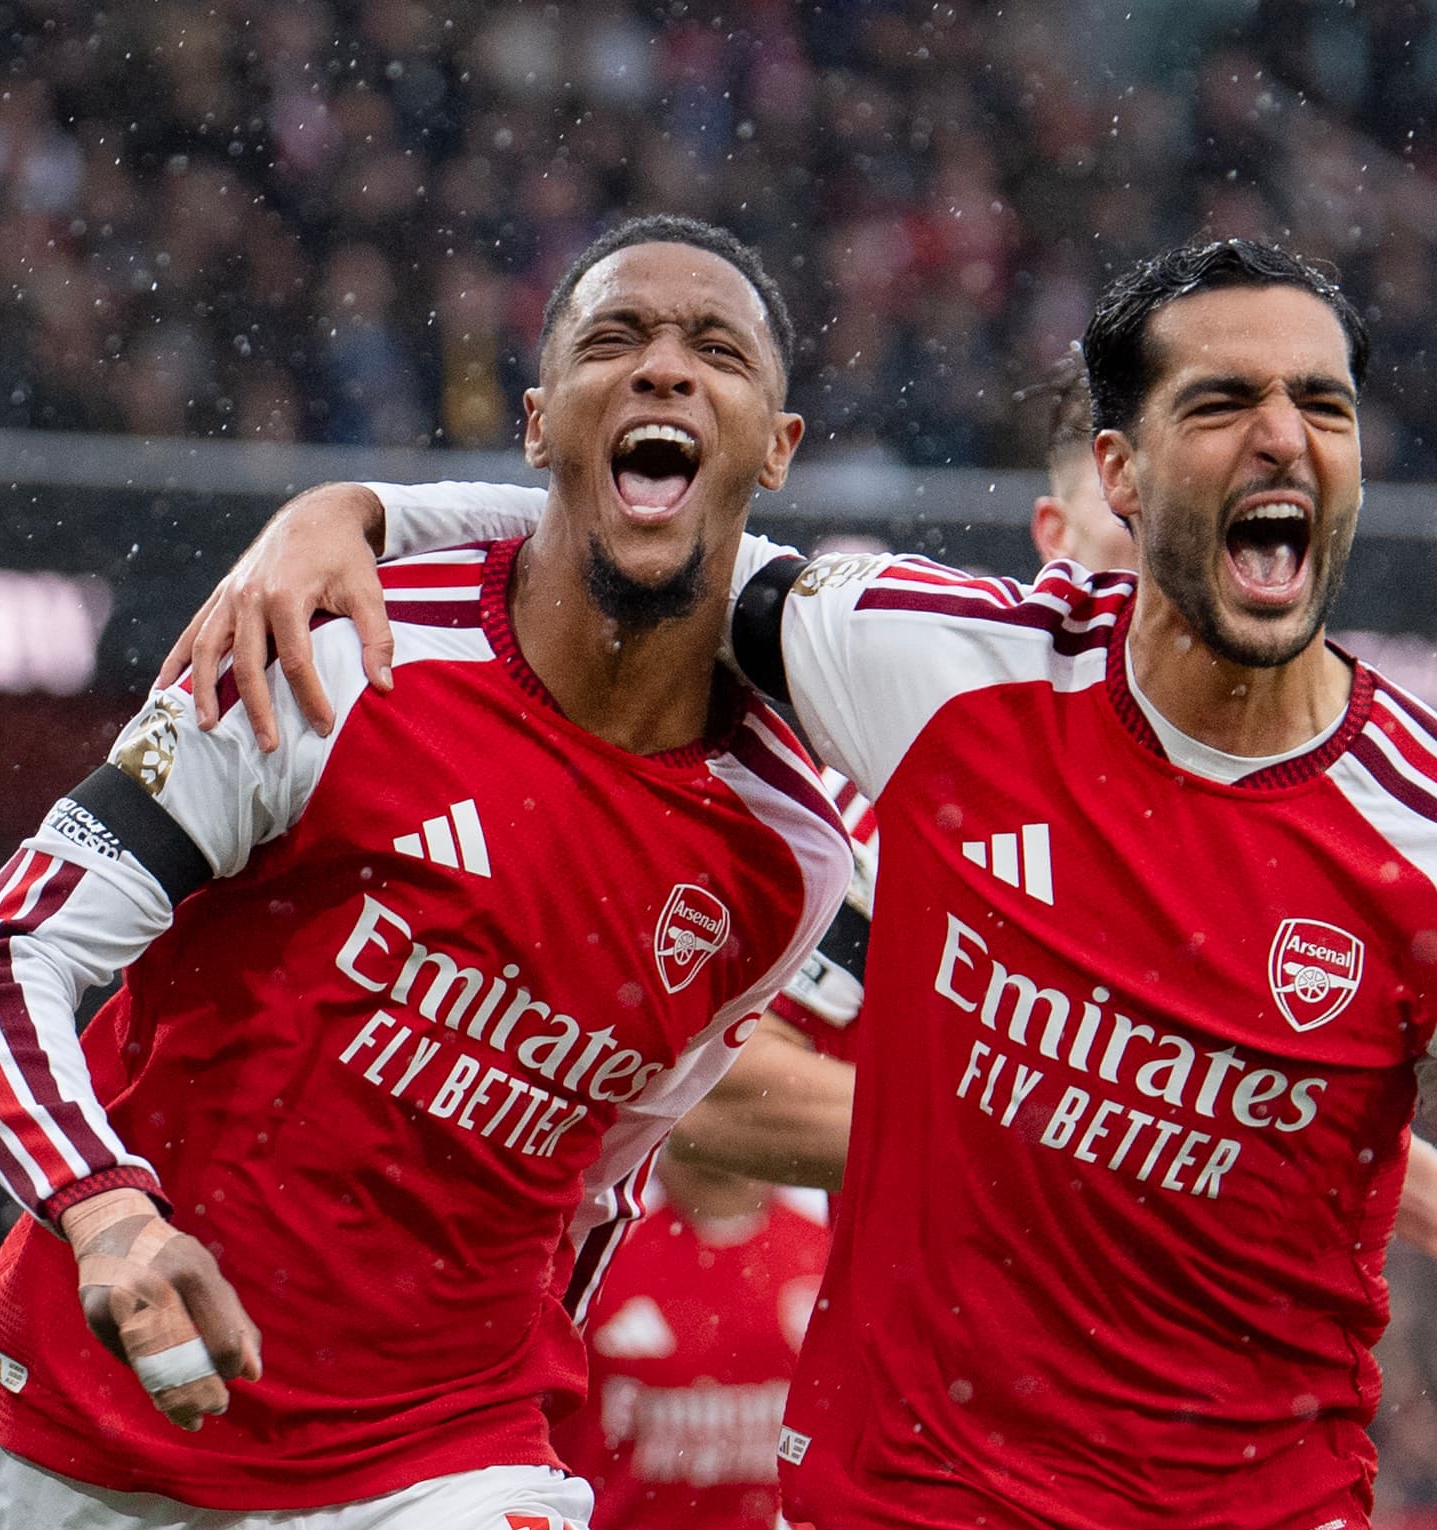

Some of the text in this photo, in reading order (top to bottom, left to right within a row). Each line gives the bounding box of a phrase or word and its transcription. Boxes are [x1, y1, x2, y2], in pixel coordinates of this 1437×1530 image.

[673, 899, 723, 935] Arsenal
[1286, 934, 1351, 967] Arsenal
[335, 893, 665, 1103] Emirates
[934, 912, 1327, 1132] Emirates
[339, 1010, 588, 1158] FLY BETTER
[957, 1040, 1242, 1199] FLY BETTER
